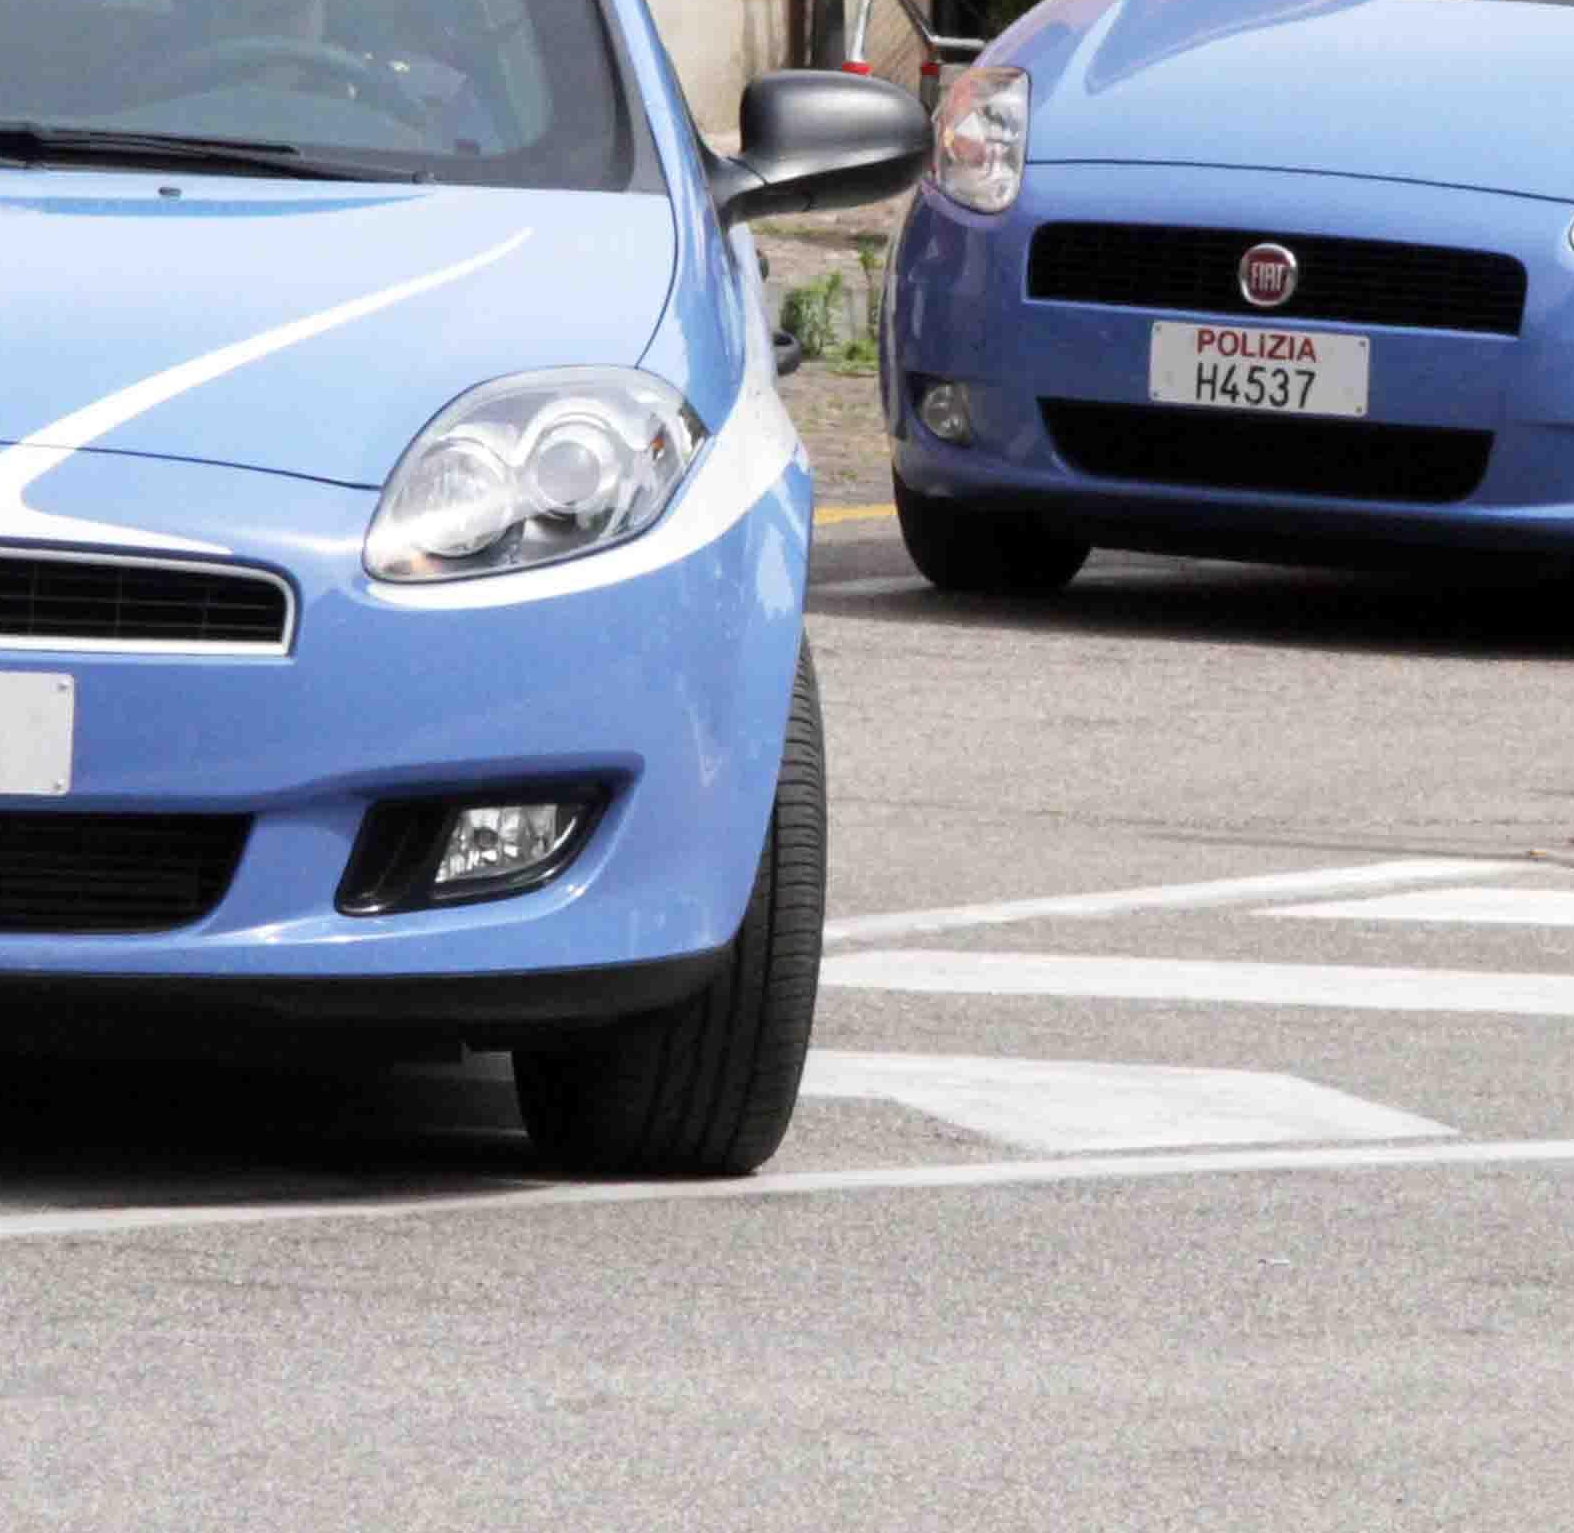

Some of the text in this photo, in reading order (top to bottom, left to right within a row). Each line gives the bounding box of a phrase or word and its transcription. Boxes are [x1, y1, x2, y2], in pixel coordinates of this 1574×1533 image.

[1249, 262, 1287, 292] FIAT
[1197, 329, 1317, 362] POLIZIA
[1196, 363, 1316, 409] H4537
